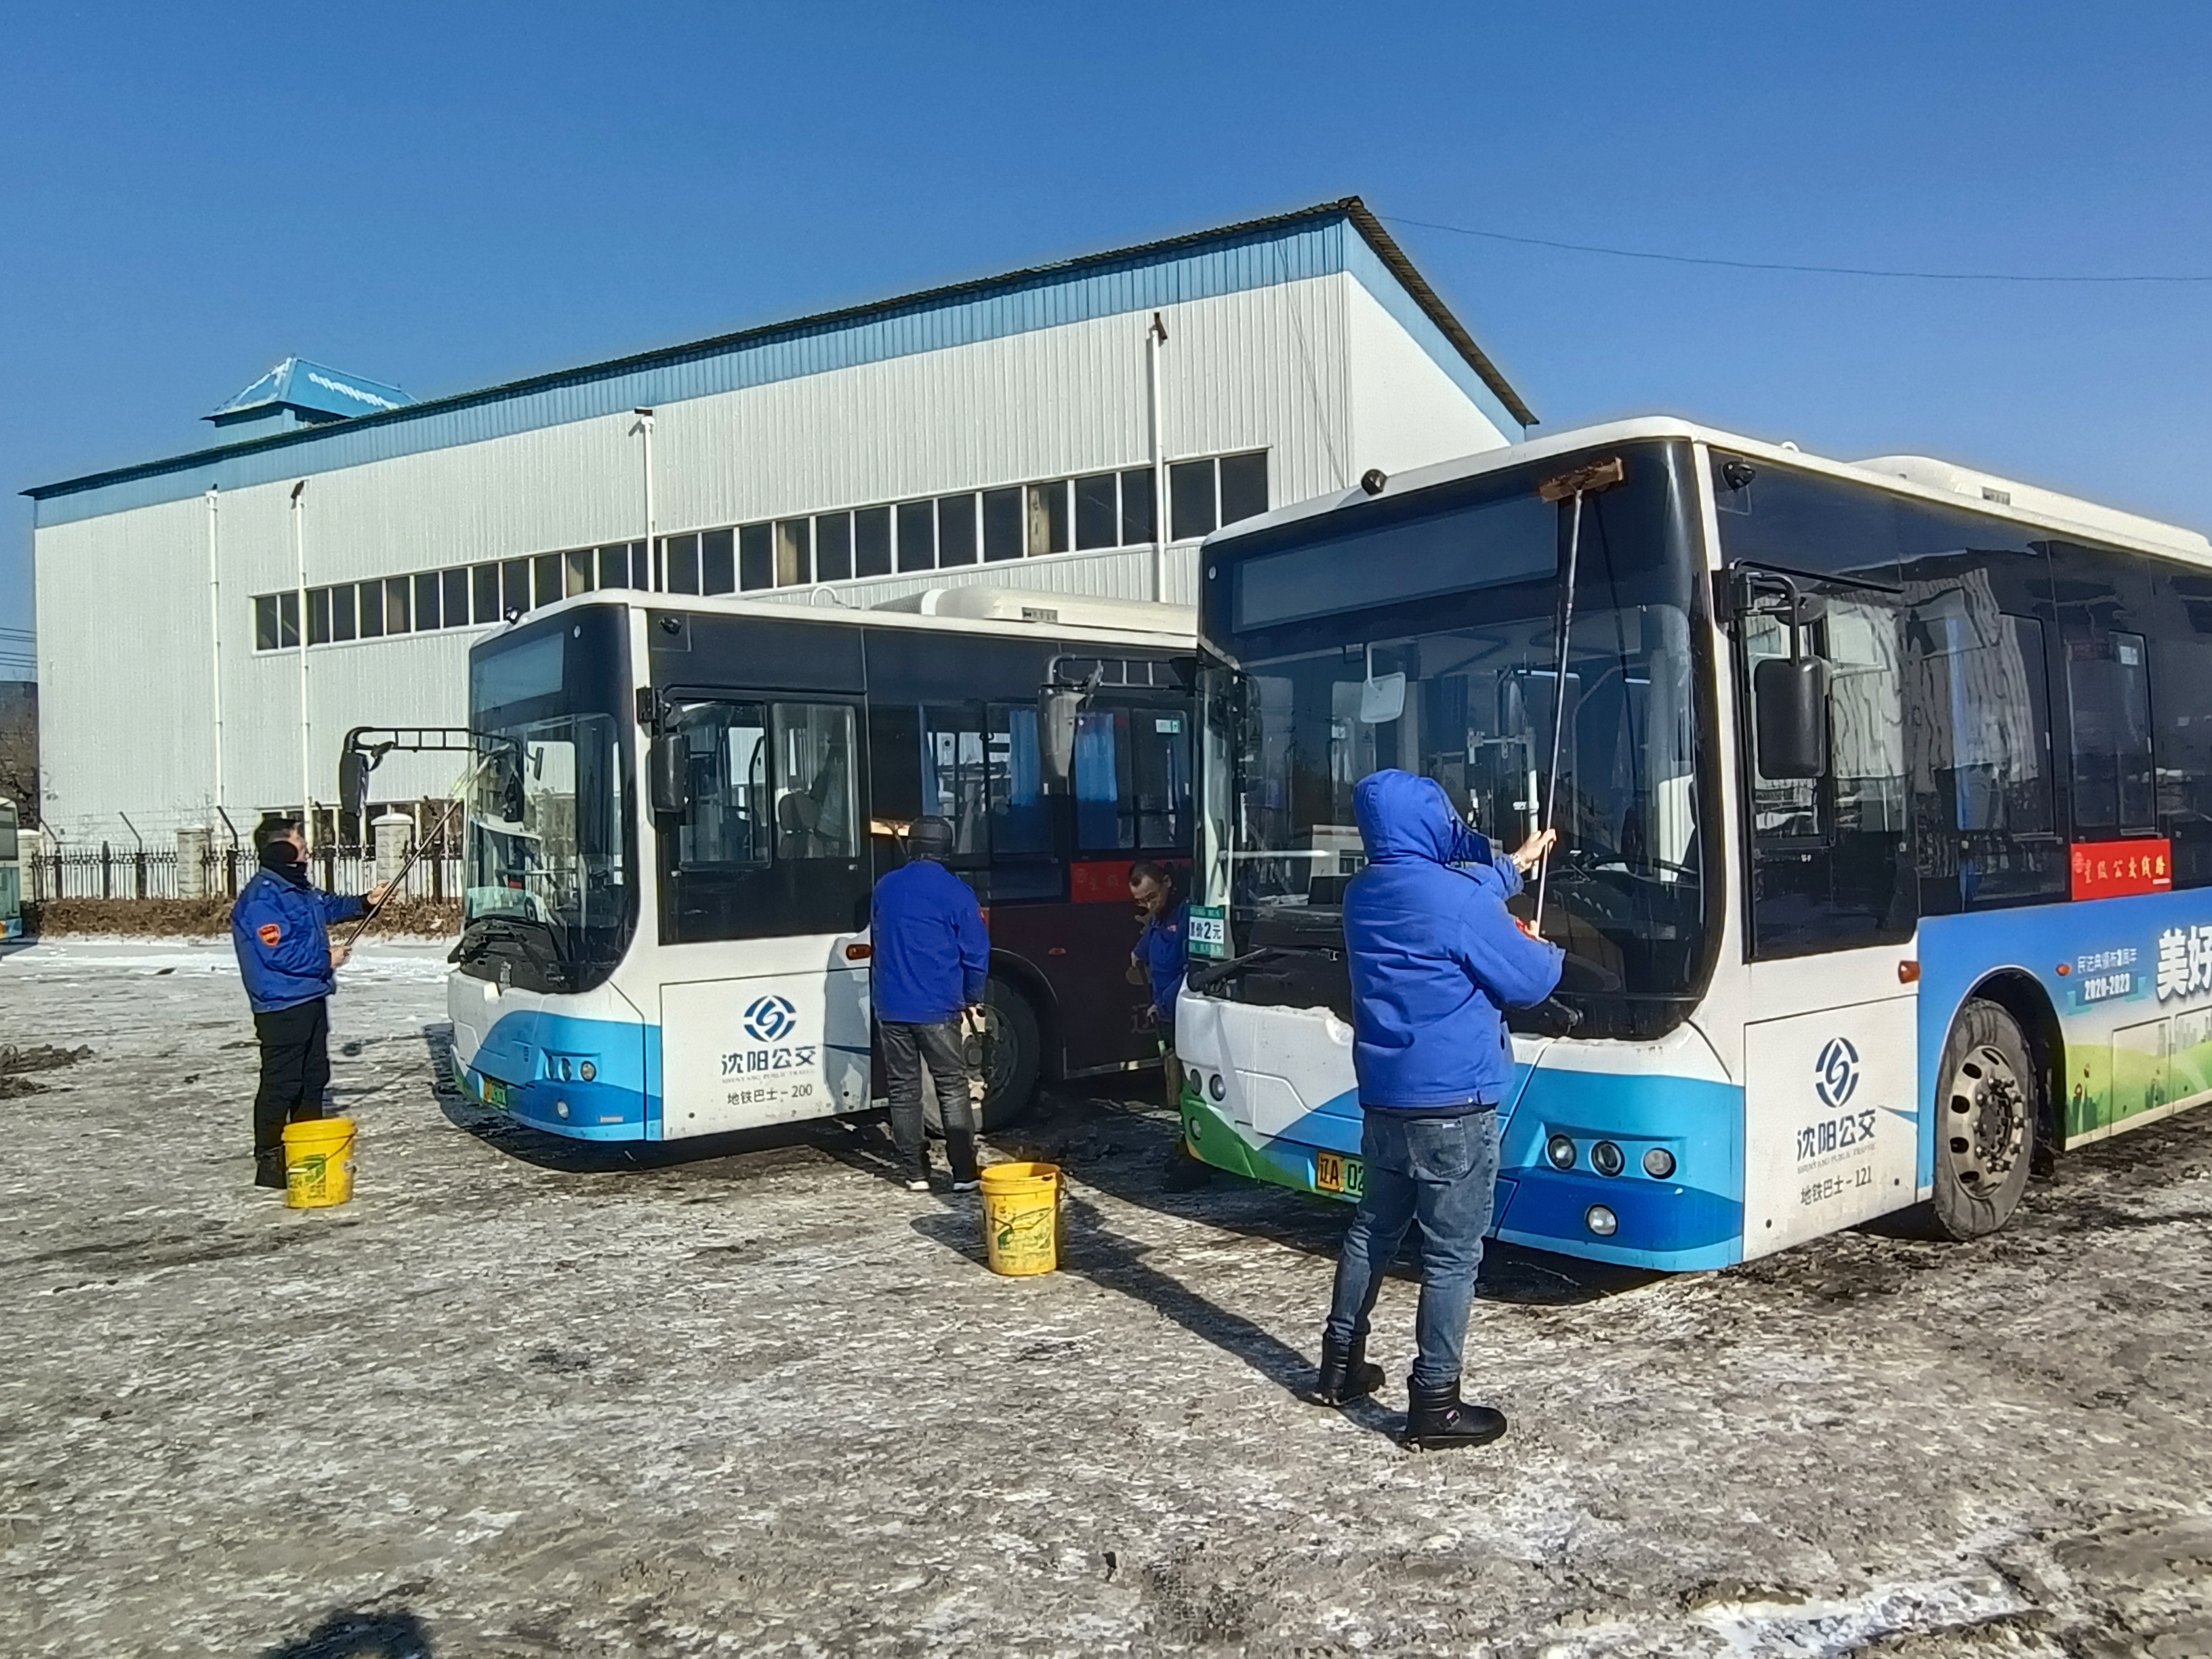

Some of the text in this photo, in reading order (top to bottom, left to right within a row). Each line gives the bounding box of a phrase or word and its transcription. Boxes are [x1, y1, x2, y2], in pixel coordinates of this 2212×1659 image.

[2157, 925, 2212, 1000] 美好
[721, 1046, 816, 1076] 沈阳公交
[1797, 1109, 1876, 1162] 沈阳公交
